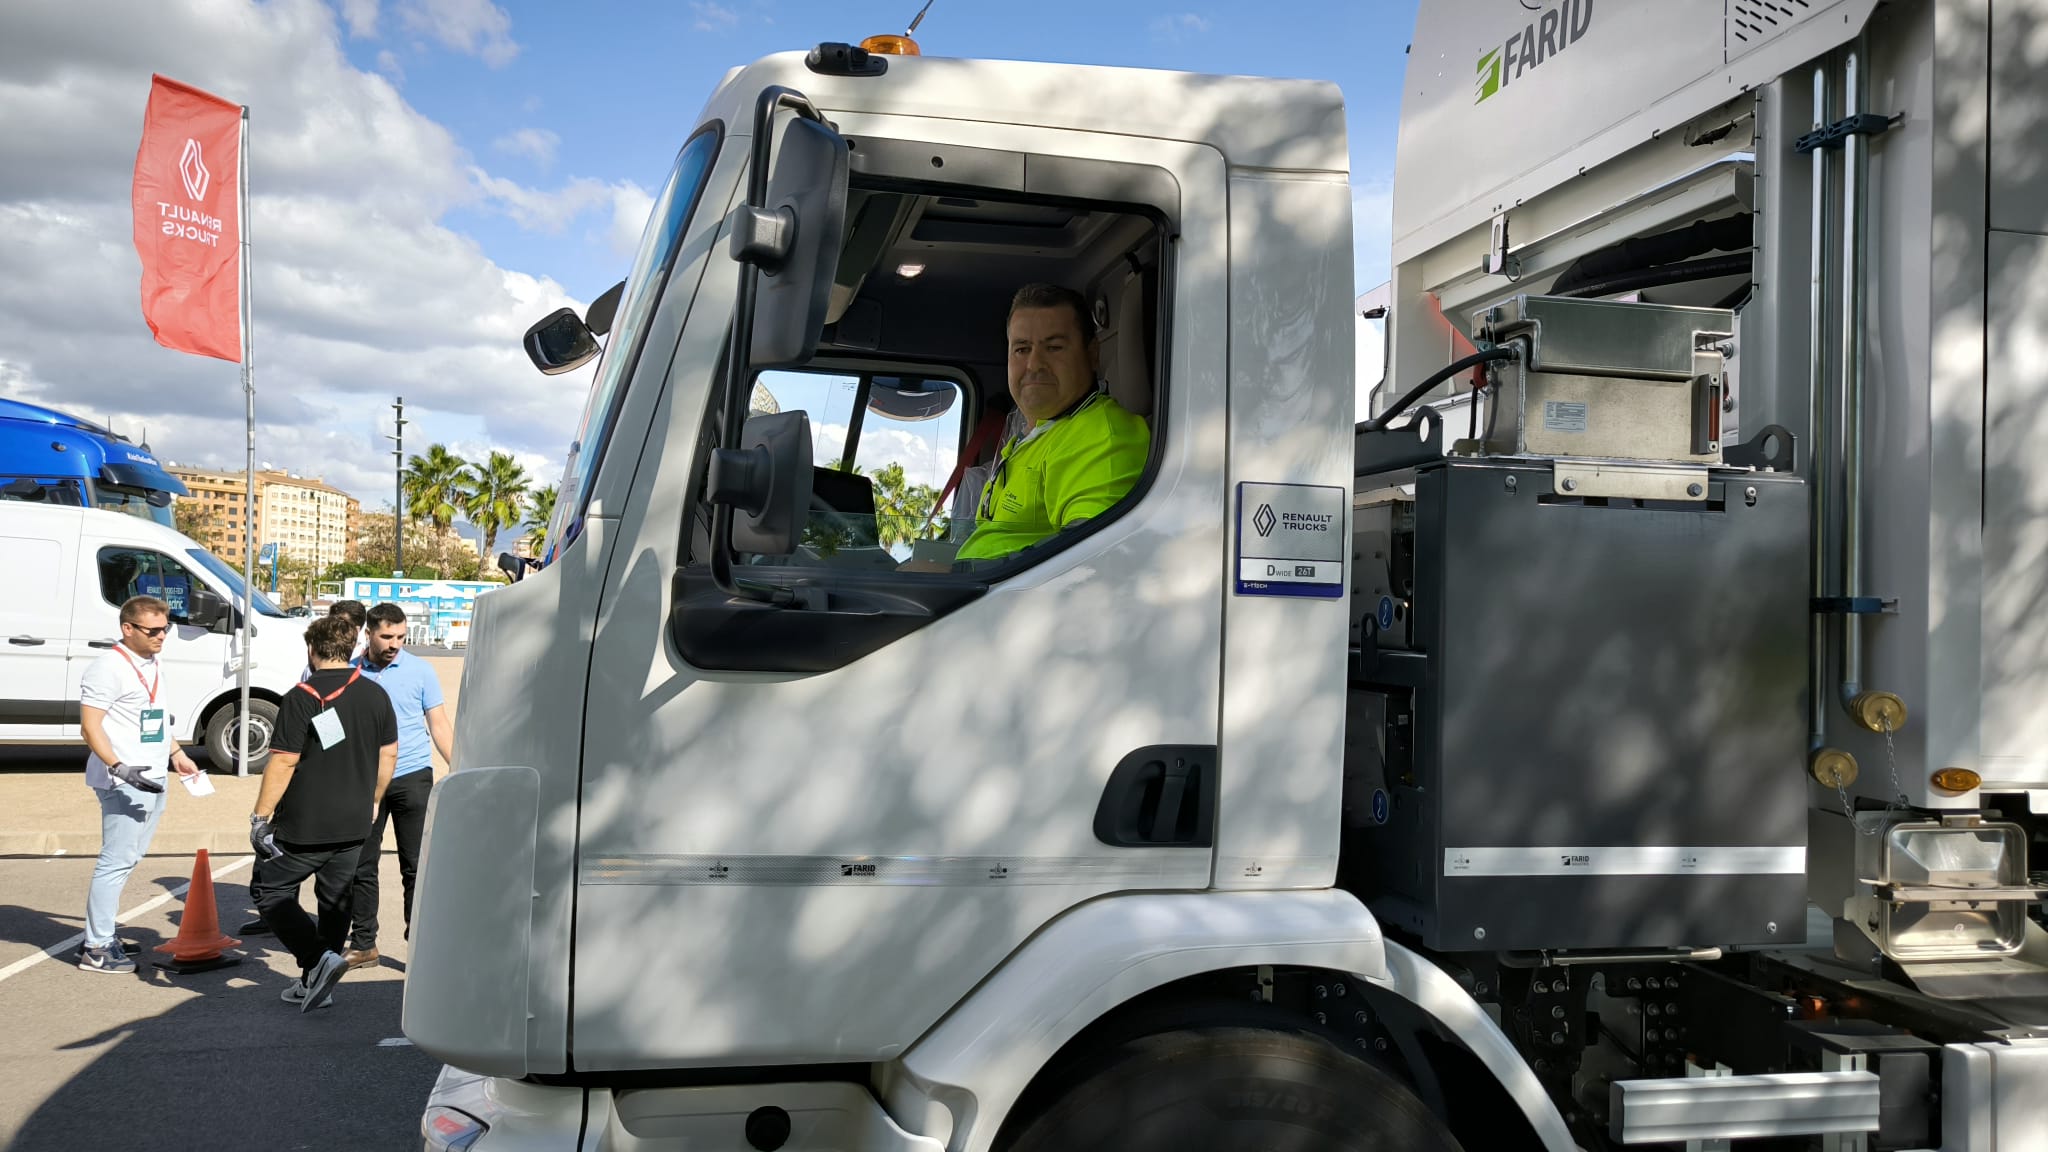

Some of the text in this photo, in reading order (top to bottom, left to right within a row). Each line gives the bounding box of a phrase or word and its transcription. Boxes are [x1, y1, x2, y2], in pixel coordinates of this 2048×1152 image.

[1502, 0, 1593, 87] FARID
[1282, 512, 1333, 523] RENAULT
[1282, 522, 1327, 532] TRUCKS
[853, 864, 876, 872] FARID
